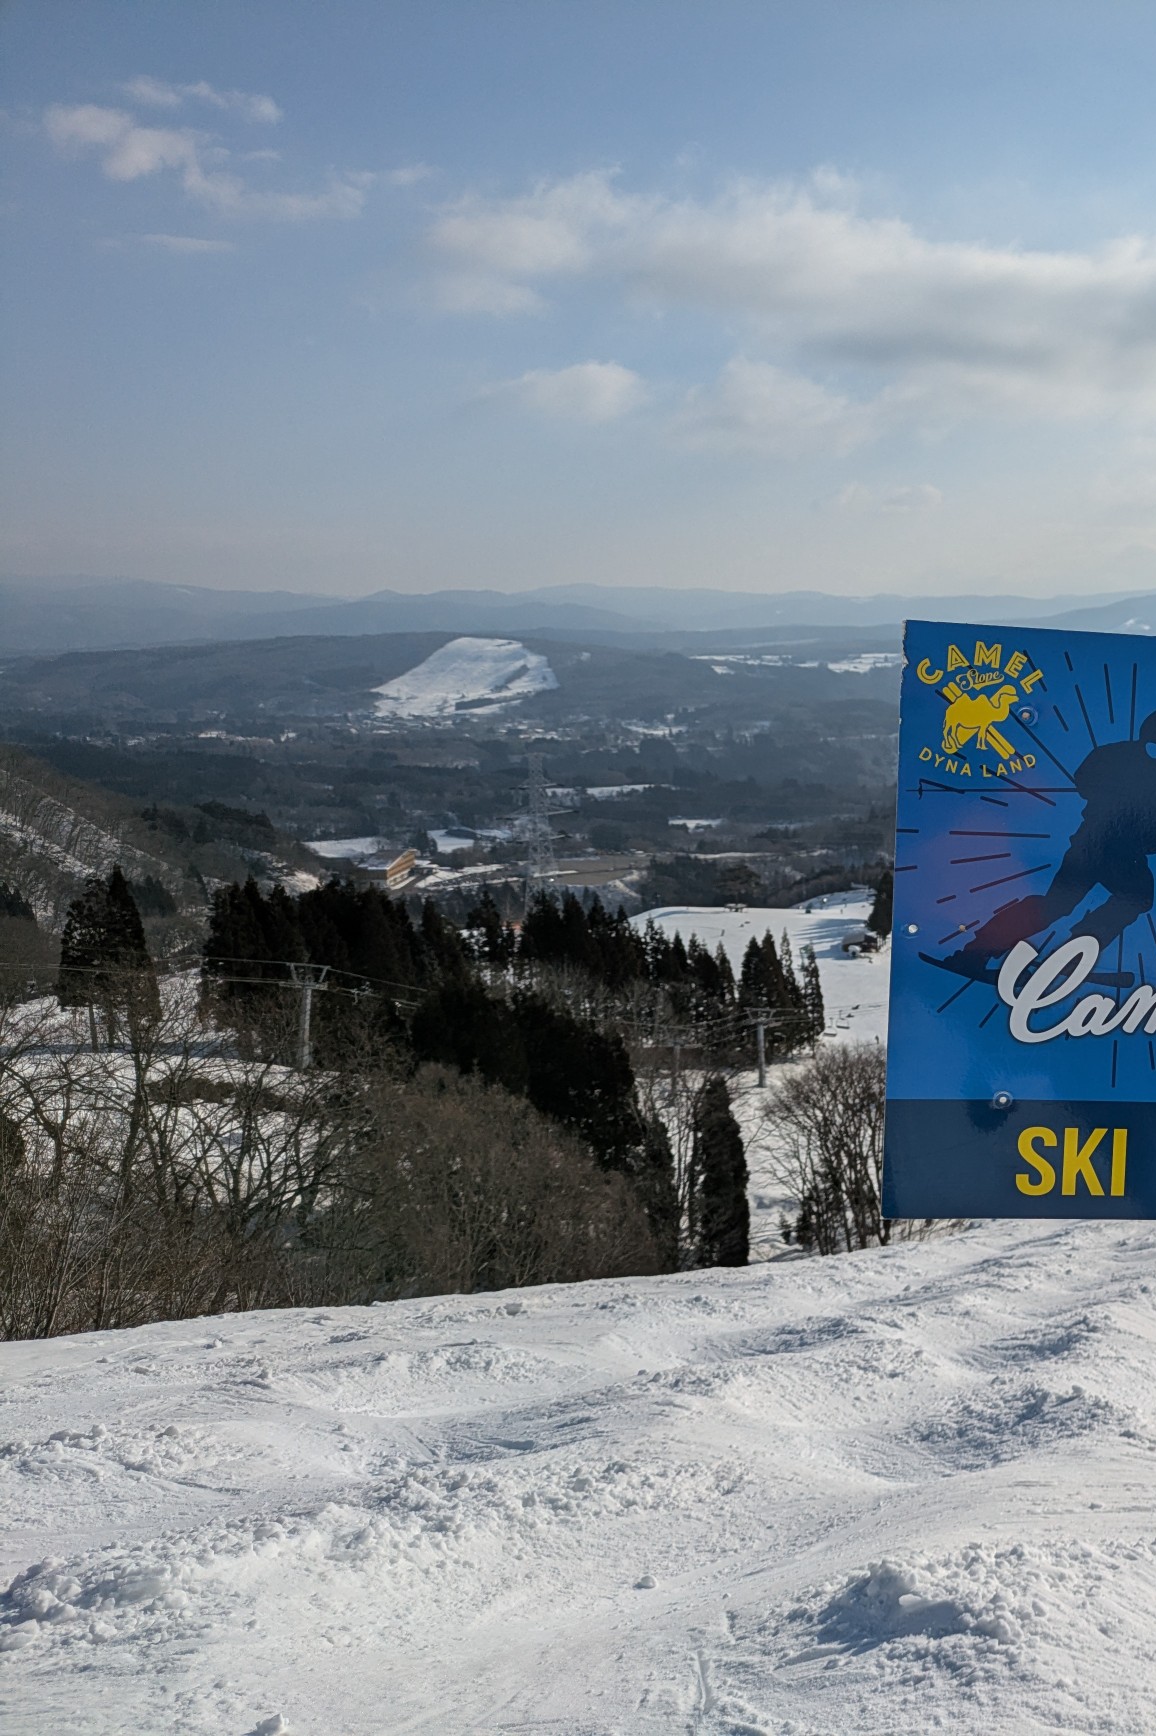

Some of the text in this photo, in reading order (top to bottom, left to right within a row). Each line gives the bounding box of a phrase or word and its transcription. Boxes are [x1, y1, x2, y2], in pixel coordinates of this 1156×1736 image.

[917, 640, 1044, 694] CAMEL
[955, 668, 1005, 691] Slope
[918, 747, 1036, 777] DYNA LAND
[1015, 1126, 1128, 1197] SKI
